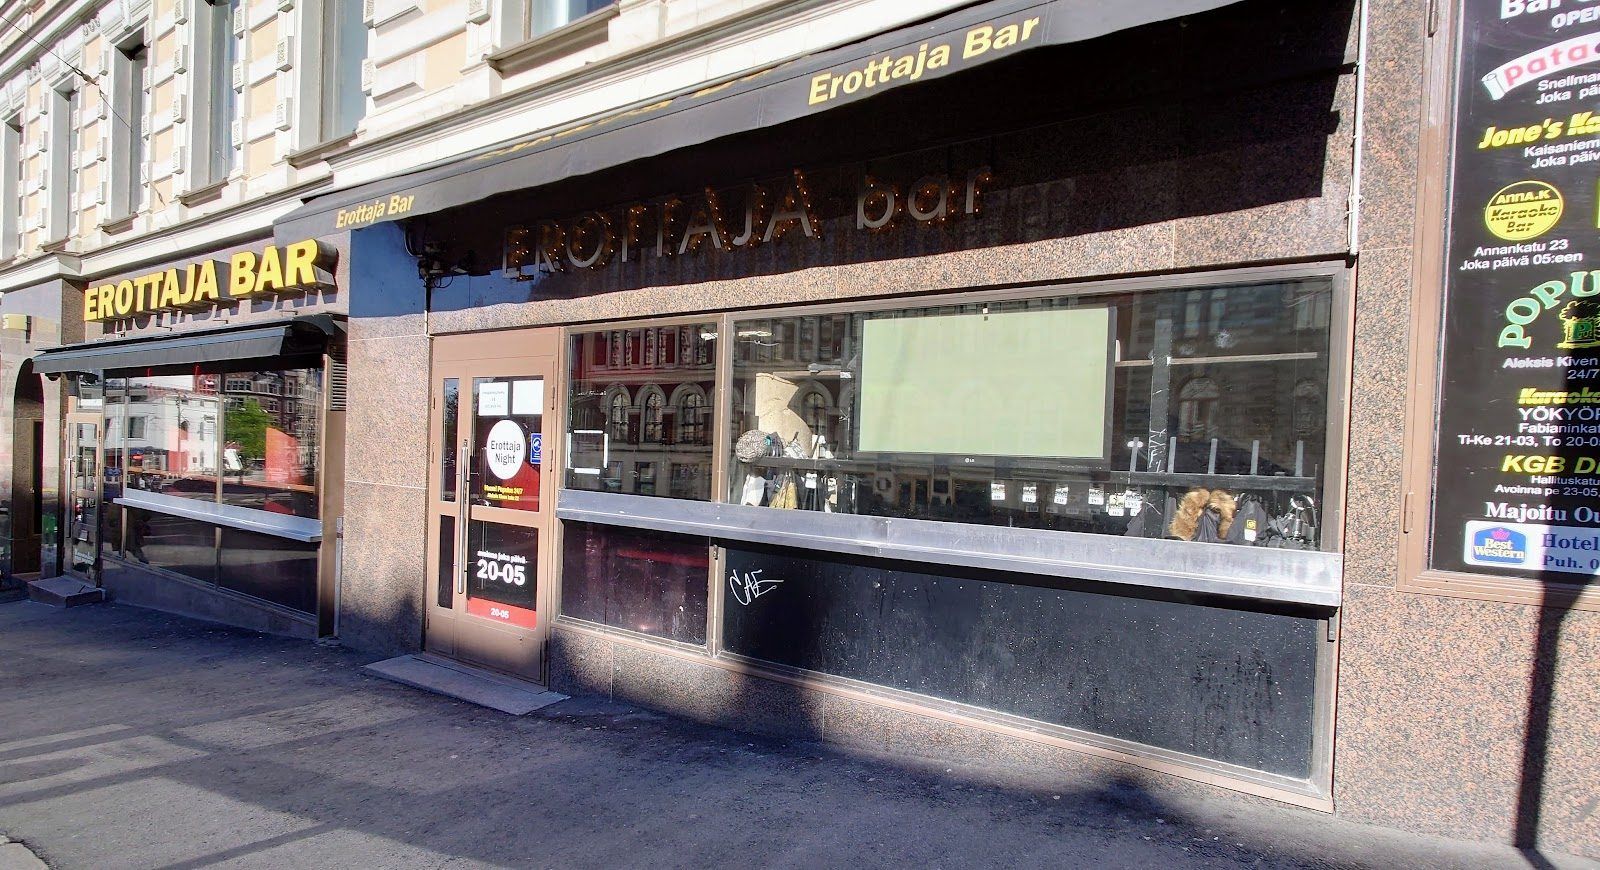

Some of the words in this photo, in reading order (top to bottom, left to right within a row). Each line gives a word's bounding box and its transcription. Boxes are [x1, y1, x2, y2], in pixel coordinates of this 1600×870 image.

[808, 43, 951, 106] Erottaja
[962, 16, 1040, 60] Bar
[1536, 90, 1572, 104] Joka
[1478, 117, 1564, 149] Jone's
[1531, 154, 1567, 169] Joka
[335, 200, 386, 229] Erottaja
[387, 194, 415, 215] Bar
[1491, 203, 1559, 222] Karaoke
[502, 167, 815, 280] EROTTAJA
[856, 165, 991, 231] bar
[1506, 221, 1534, 233] Bar
[1474, 242, 1546, 257] Annankatu
[1549, 239, 1569, 251] 23
[1460, 259, 1490, 271] Joka
[1493, 256, 1530, 270] päivä
[1533, 252, 1583, 265] 05:een
[83, 259, 220, 322] EROTTAJA
[229, 238, 319, 297] BAR
[1502, 357, 1554, 369] Aleksis
[1556, 356, 1599, 368] Kiven
[1567, 368, 1600, 380] 24/7
[490, 440, 521, 453] Erottaja
[1458, 434, 1492, 446] Ti-Ke
[1494, 435, 1539, 448] 21-03,
[1542, 435, 1561, 446] To
[495, 453, 516, 466] Night
[1502, 454, 1566, 474] KGB
[1494, 484, 1542, 495] Avoinna
[1544, 487, 1560, 497] pe
[1485, 501, 1568, 523] Majoitu
[1485, 538, 1514, 550] Best
[1542, 533, 1599, 551] Hotel
[1473, 545, 1526, 558] Western
[1543, 554, 1583, 569] Puh.
[476, 558, 526, 586] 20-05
[490, 607, 510, 619] 20-05
